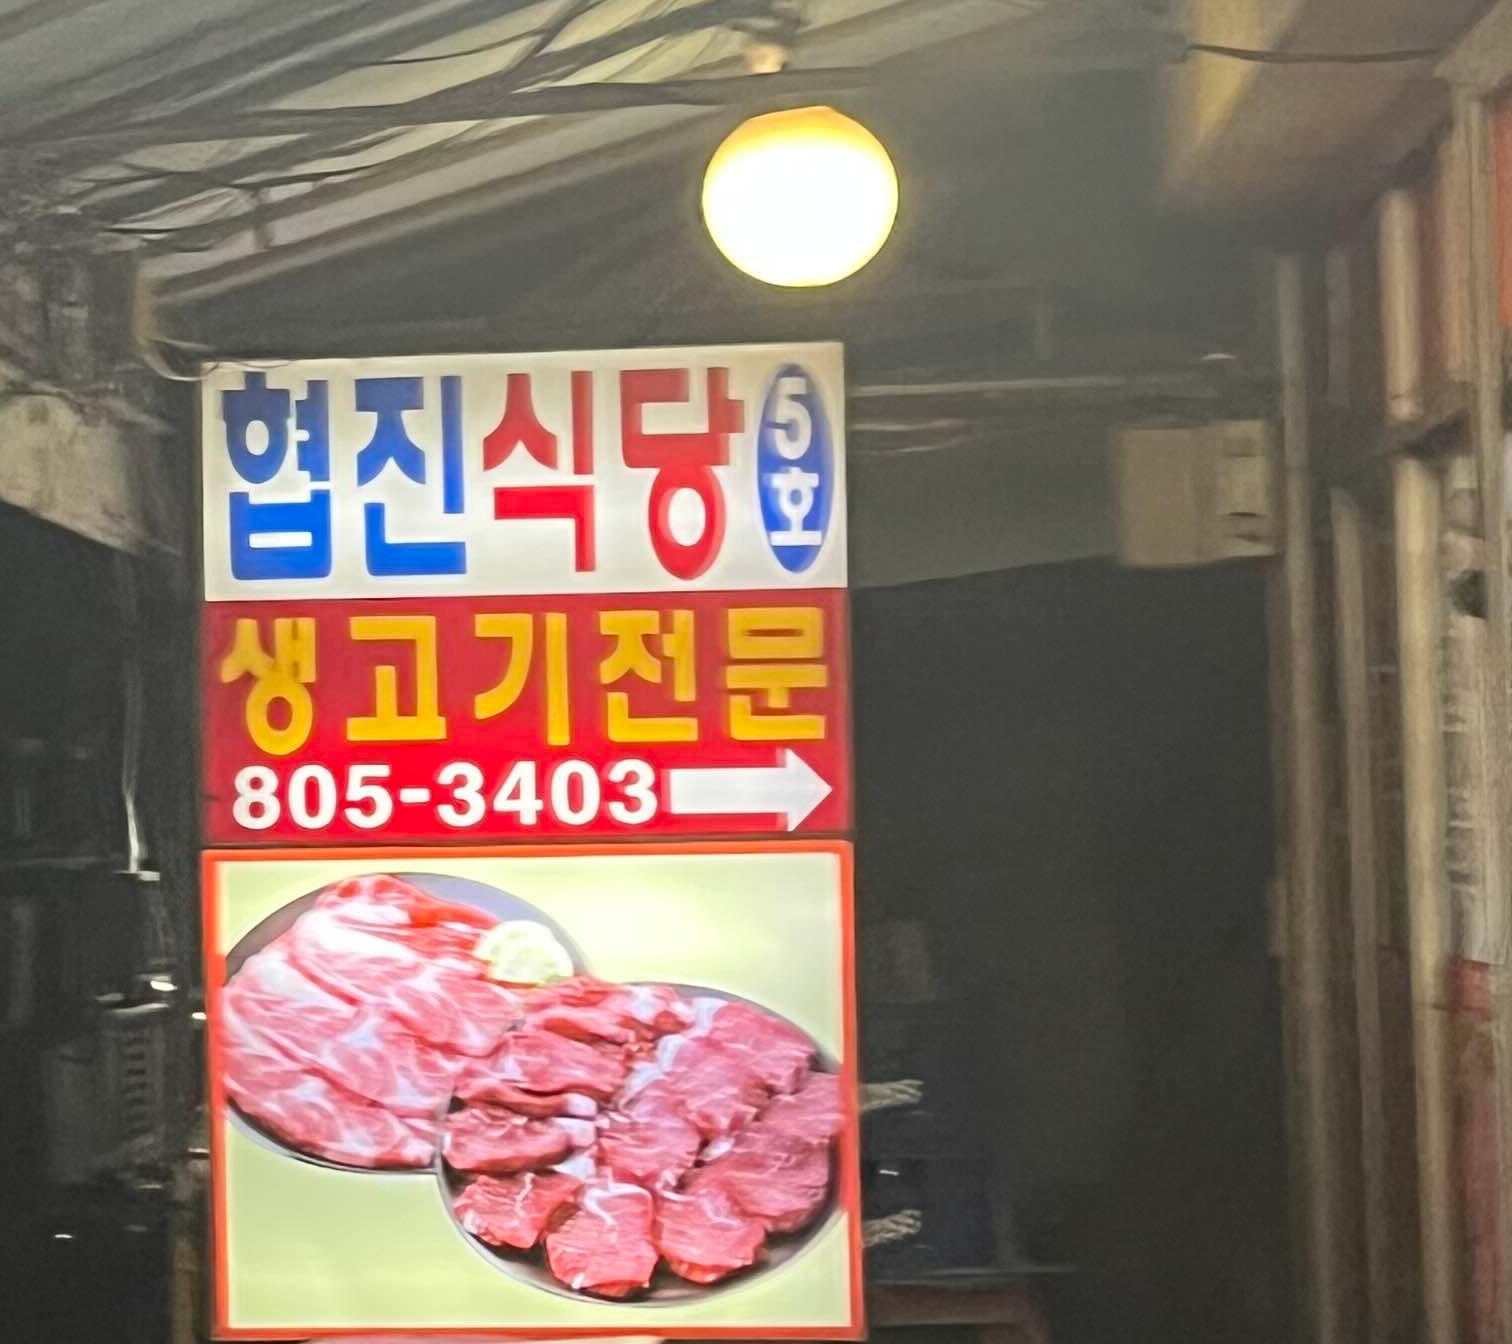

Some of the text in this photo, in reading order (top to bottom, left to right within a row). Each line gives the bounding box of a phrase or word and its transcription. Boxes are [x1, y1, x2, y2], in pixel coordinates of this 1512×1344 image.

[221, 366, 745, 581] 협진식당
[766, 375, 823, 547] 5호
[221, 607, 829, 755] 생고기전문
[233, 759, 658, 830] 805-3403
